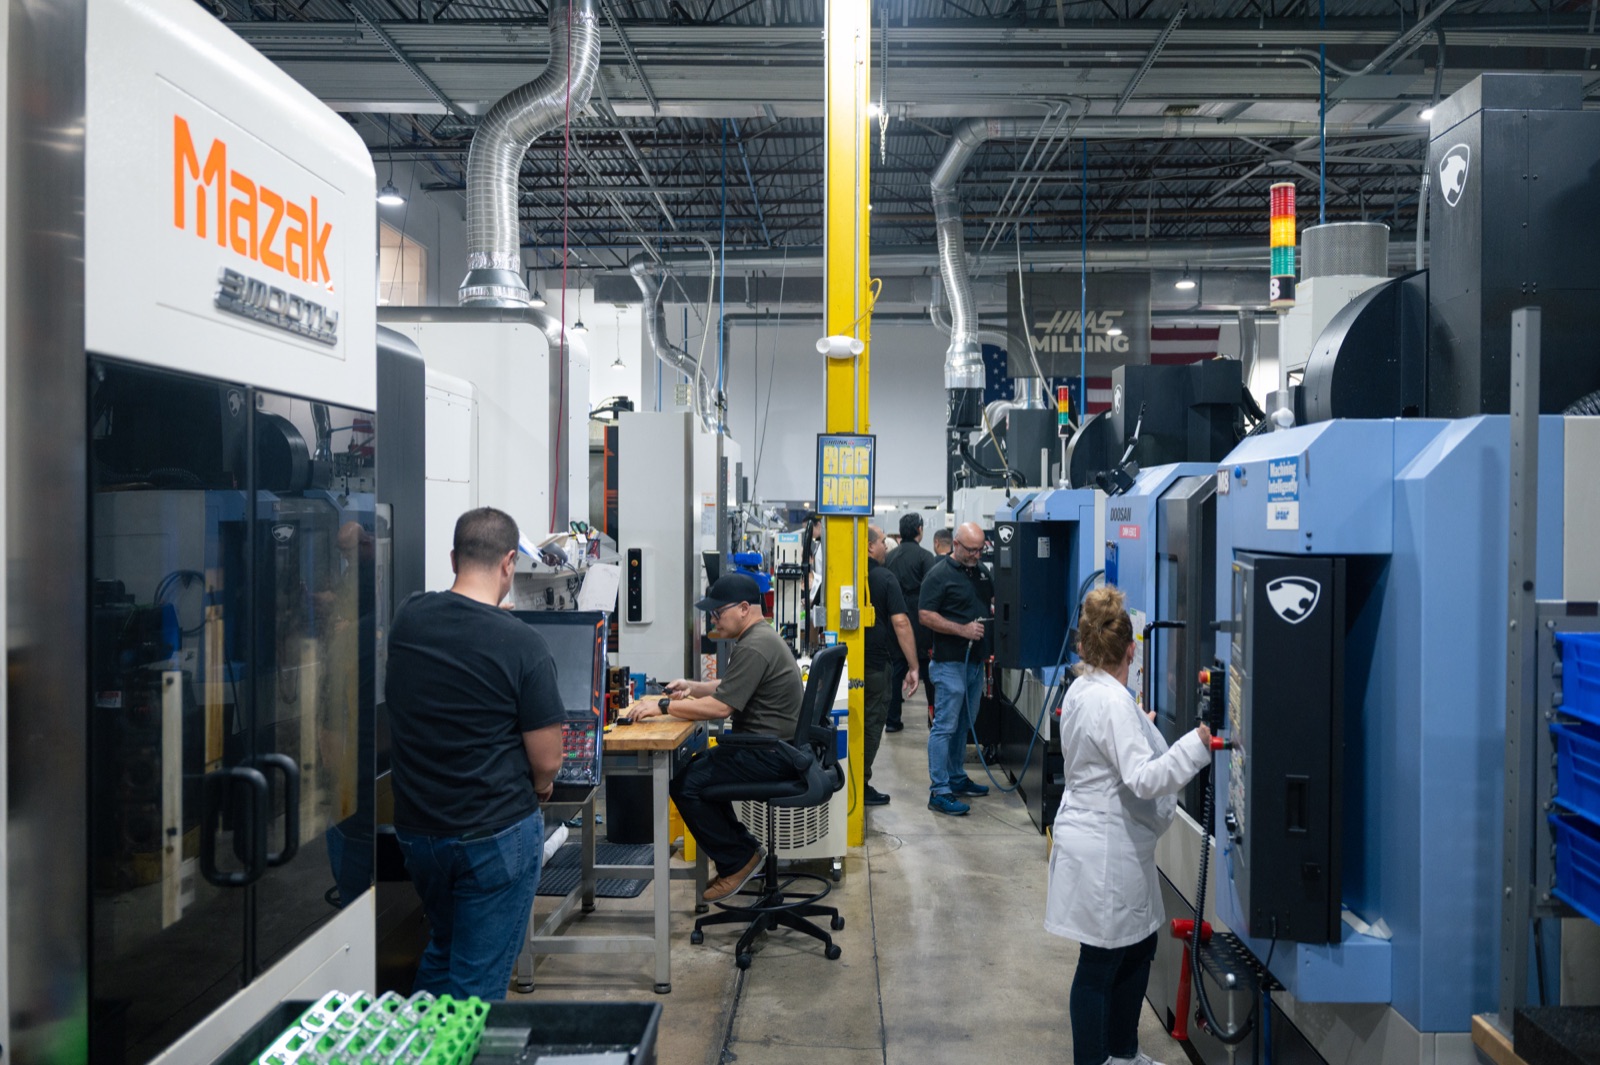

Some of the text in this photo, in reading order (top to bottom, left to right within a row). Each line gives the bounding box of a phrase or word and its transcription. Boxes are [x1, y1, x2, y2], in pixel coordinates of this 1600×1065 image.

[174, 115, 334, 292] Mazak
[1034, 310, 1124, 334] HAAS
[1030, 334, 1130, 353] MILLING
[1110, 507, 1132, 522] DOOSAN
